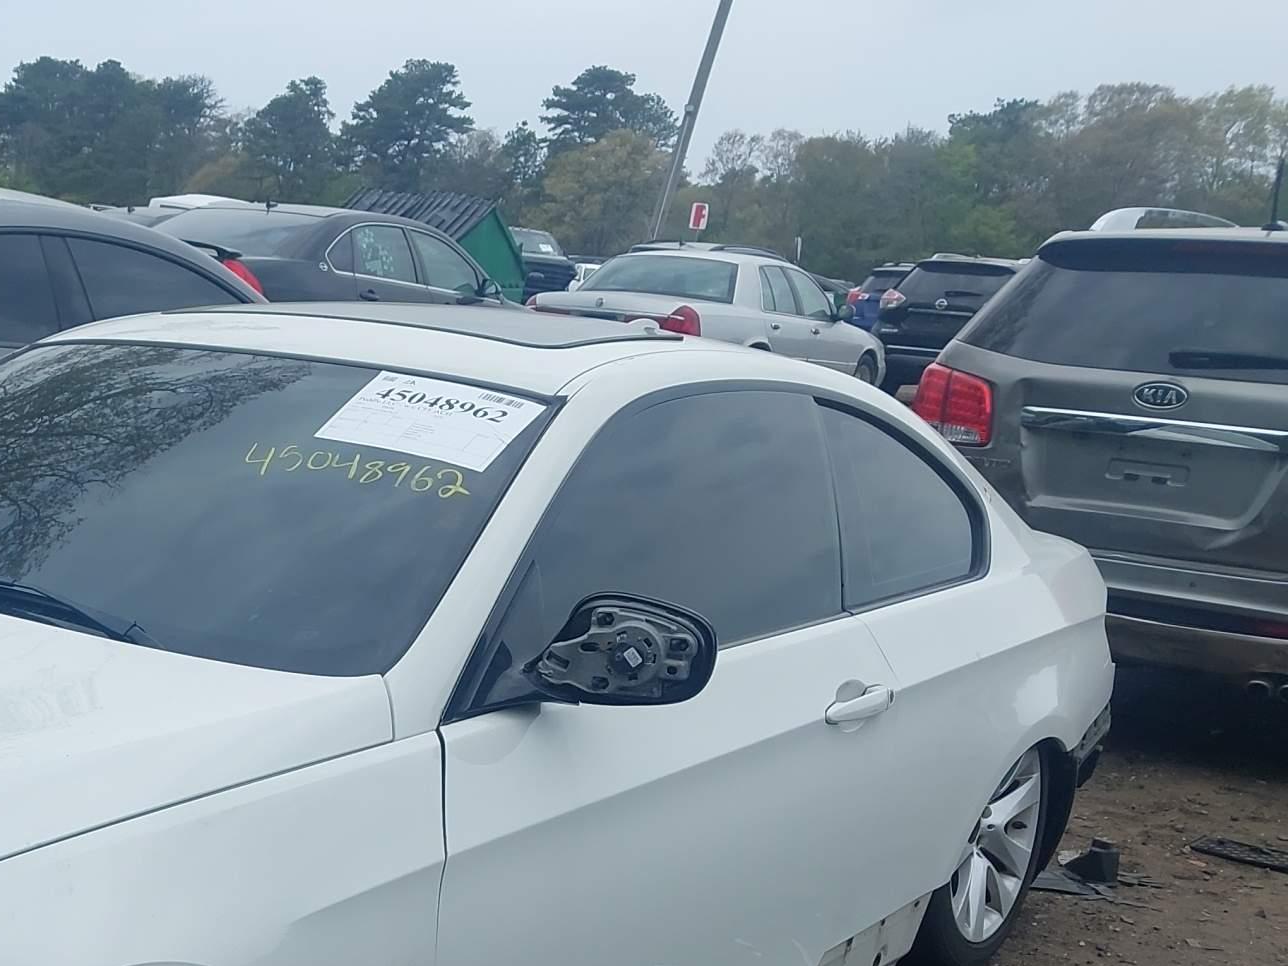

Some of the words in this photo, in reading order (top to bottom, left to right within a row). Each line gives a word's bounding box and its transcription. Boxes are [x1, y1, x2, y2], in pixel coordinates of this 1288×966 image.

[375, 387, 509, 424] 45048962
[1142, 387, 1177, 405] KIA
[243, 441, 472, 499] 45048962
